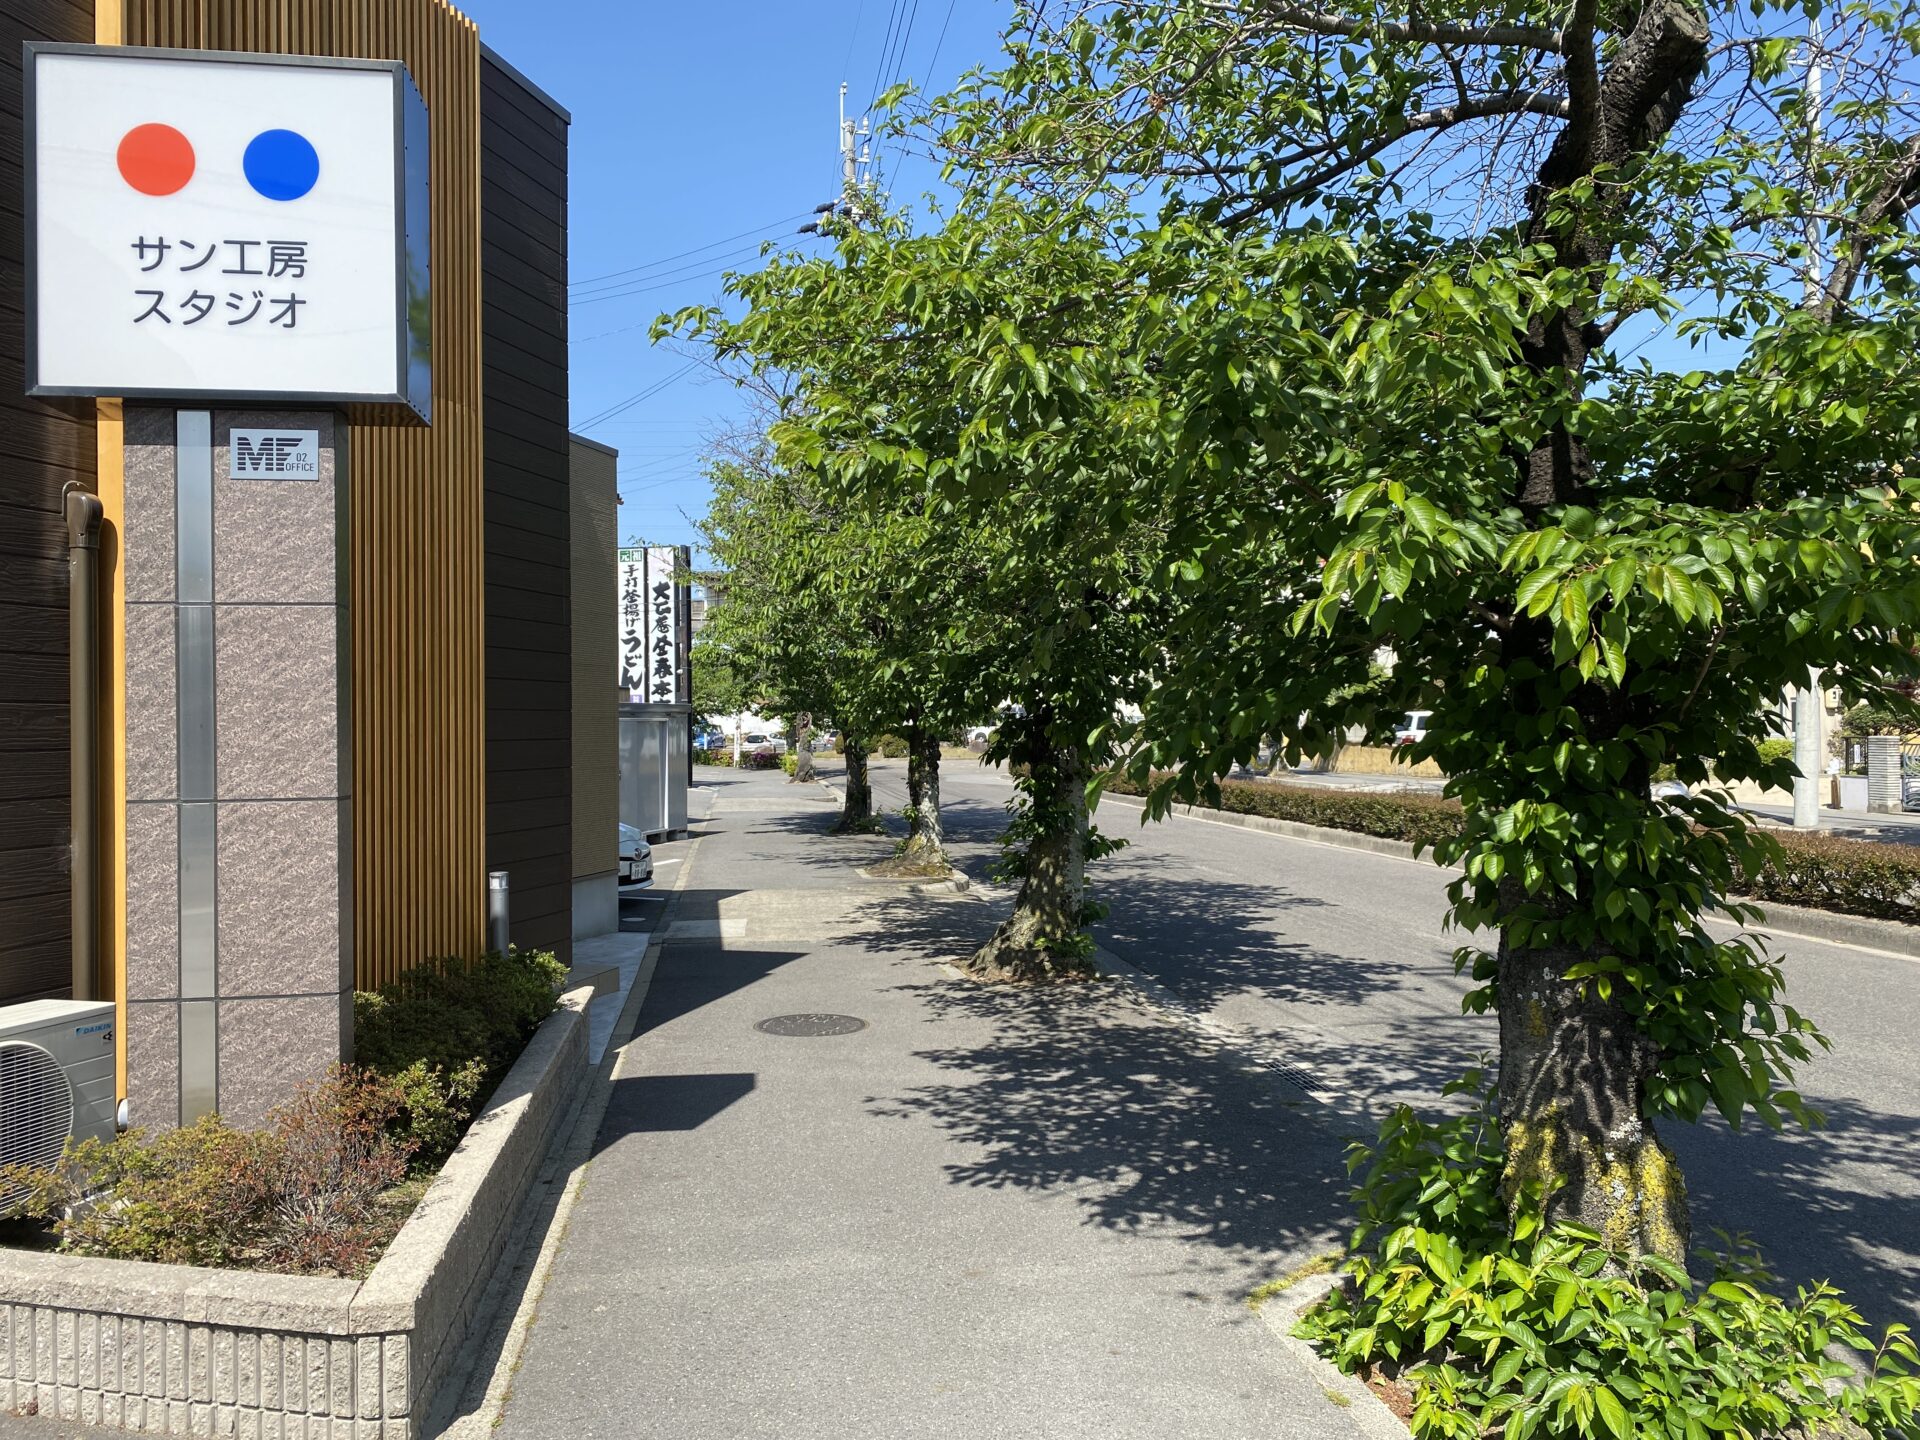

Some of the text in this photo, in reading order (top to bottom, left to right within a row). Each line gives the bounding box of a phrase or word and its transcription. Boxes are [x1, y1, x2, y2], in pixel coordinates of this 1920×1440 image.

[130, 235, 309, 278] サン工房
[133, 289, 307, 329] スタジオ
[237, 436, 304, 471] MF
[296, 452, 307, 462] 02
[285, 462, 315, 472] OFFICE
[620, 550, 642, 562] 元祖
[83, 1023, 112, 1034] DAIKIN
